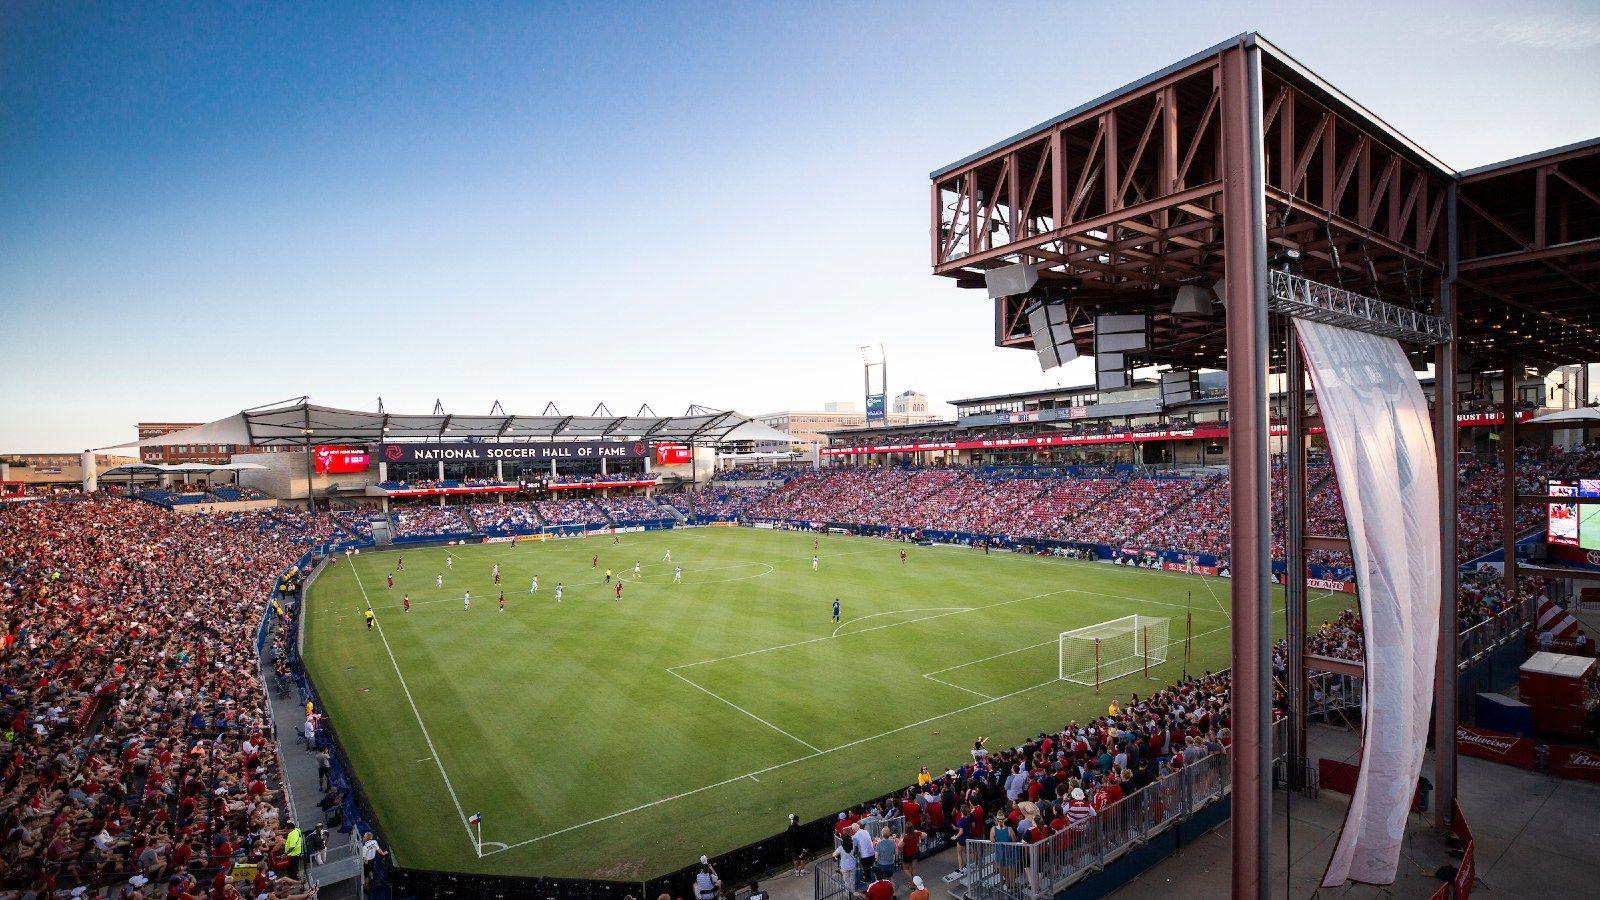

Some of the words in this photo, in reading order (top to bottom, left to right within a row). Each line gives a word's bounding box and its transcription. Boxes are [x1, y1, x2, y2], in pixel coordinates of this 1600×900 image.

[414, 449, 480, 459] NATIONAL
[486, 448, 536, 458] SOCCER
[542, 447, 571, 457] HALL
[577, 447, 592, 456] OF
[598, 447, 626, 456] FAME
[1456, 730, 1512, 749] Budweiser
